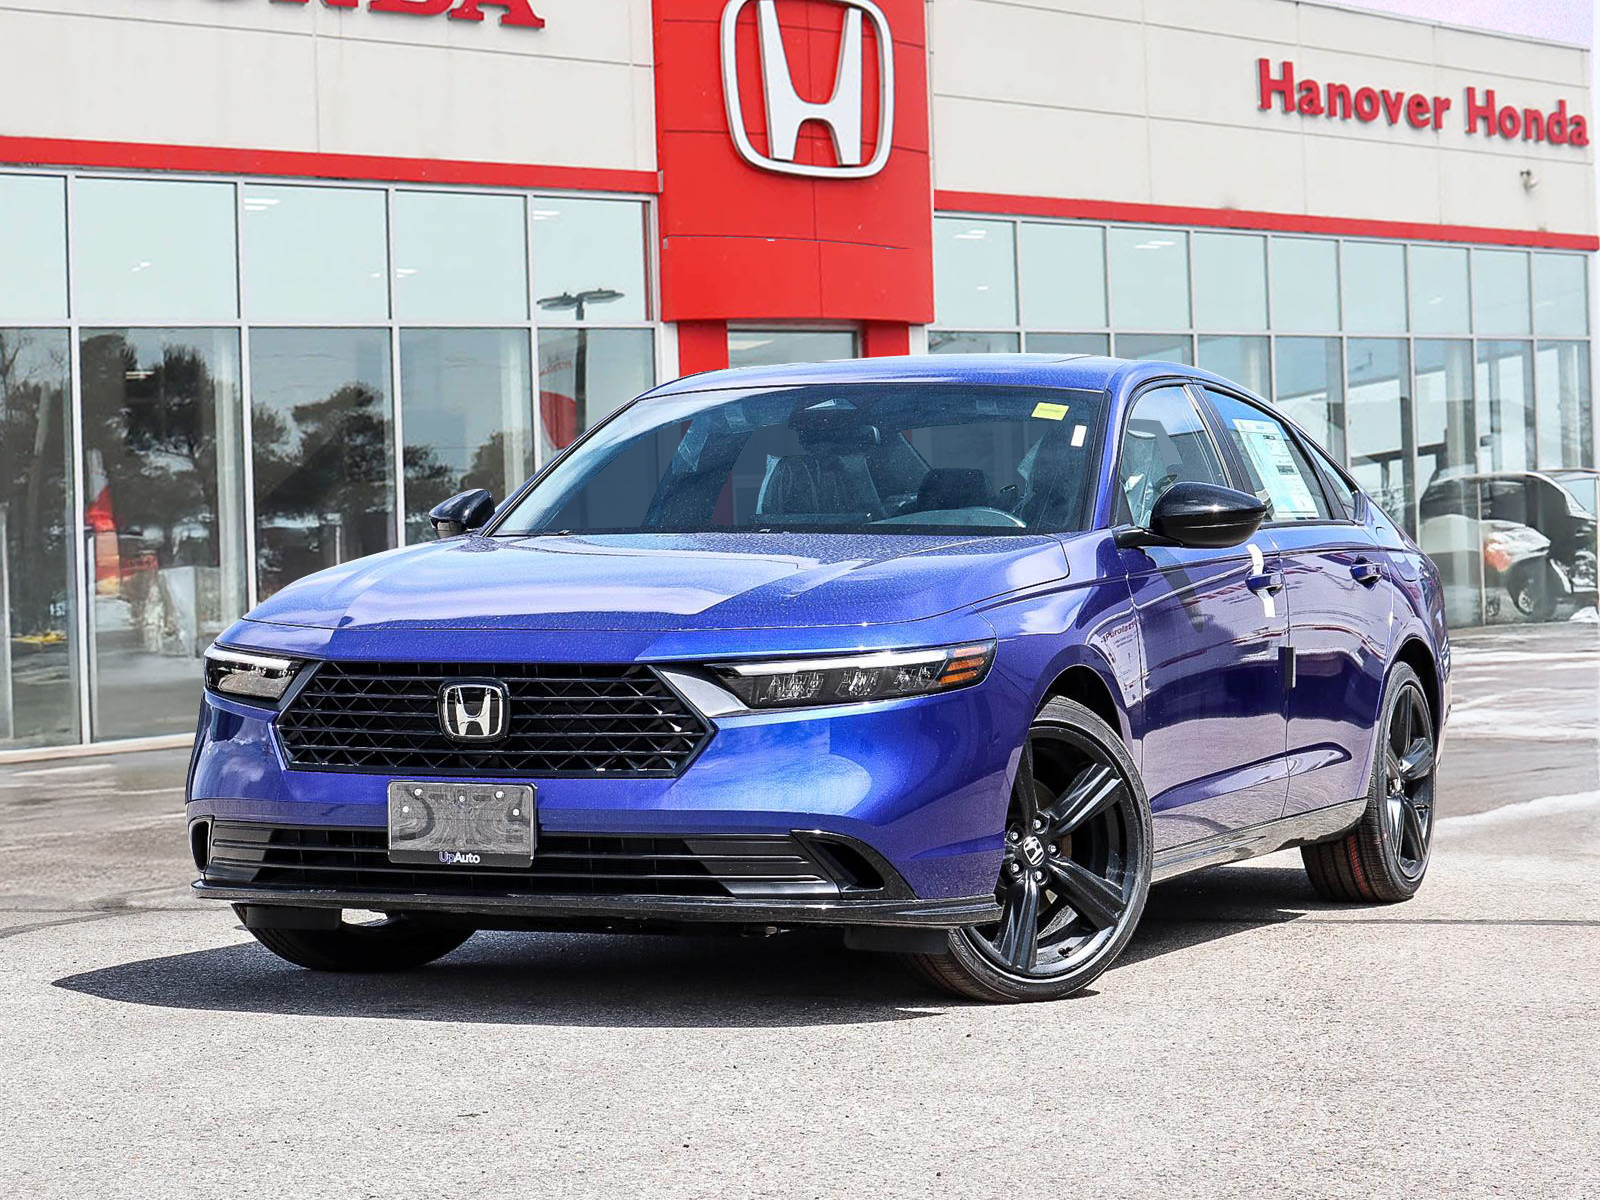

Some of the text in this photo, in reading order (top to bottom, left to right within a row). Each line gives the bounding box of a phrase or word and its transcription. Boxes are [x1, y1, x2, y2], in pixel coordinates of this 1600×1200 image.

[1257, 57, 1590, 147] Hanover Honda
[438, 851, 481, 865] UpAuto
